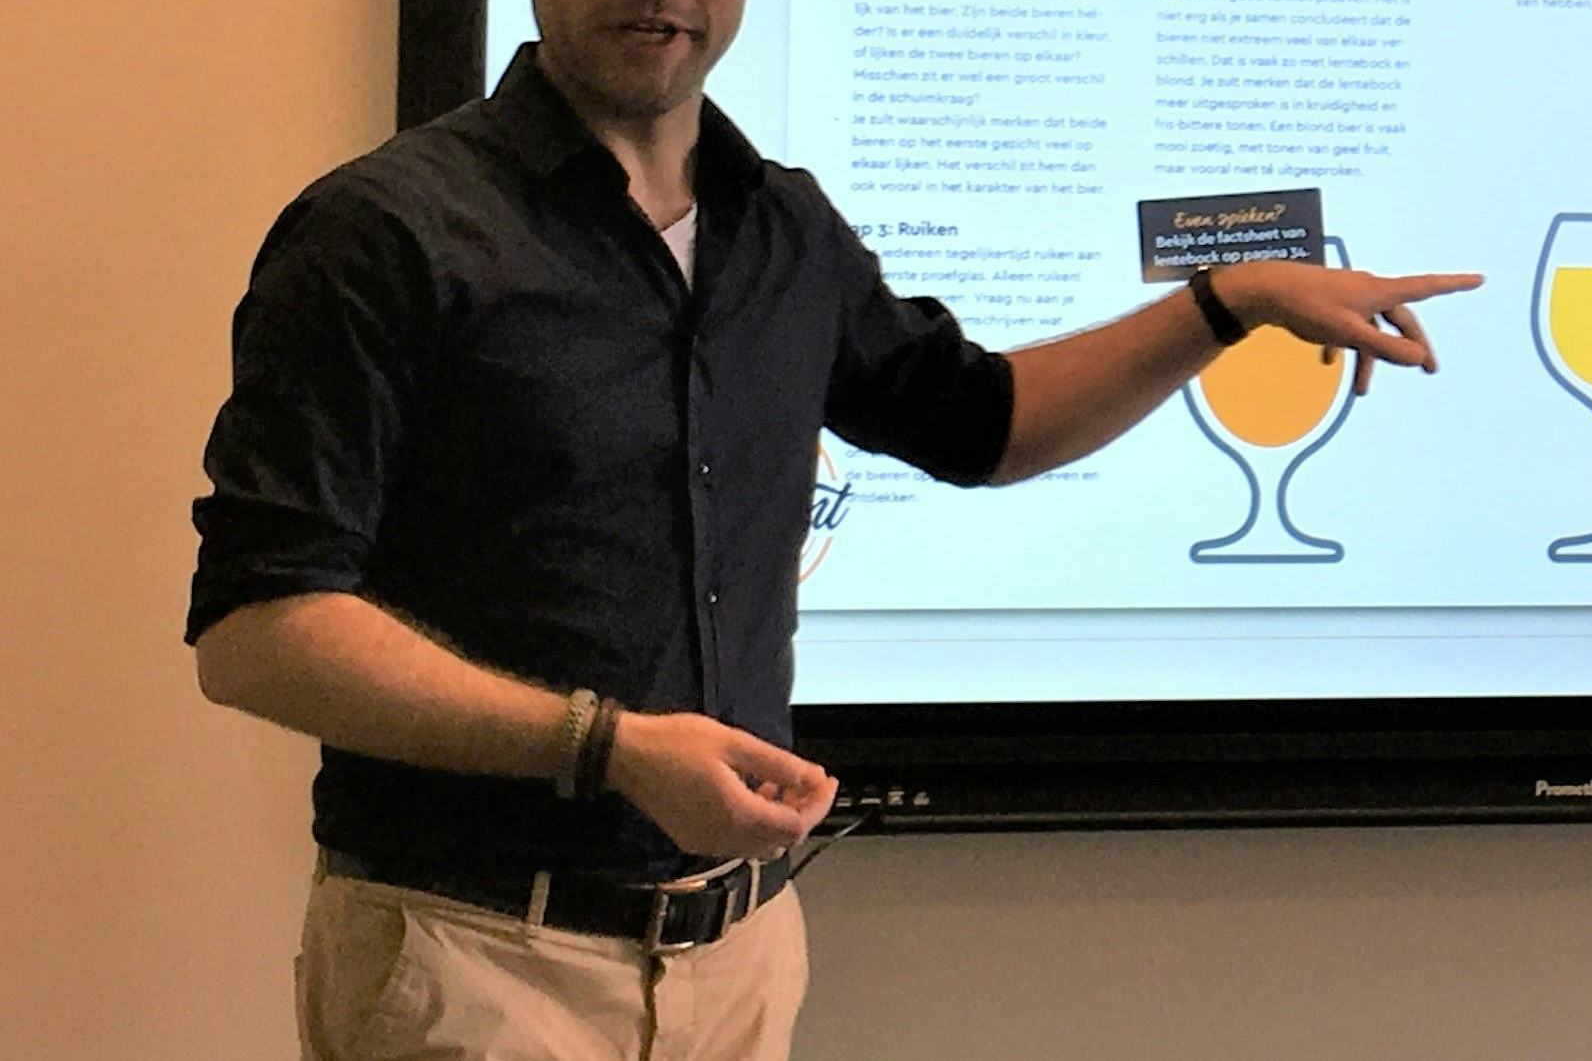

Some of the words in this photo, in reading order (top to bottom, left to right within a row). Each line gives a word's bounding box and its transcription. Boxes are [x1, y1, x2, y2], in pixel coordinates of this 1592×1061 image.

[1260, 163, 1274, 175] té
[878, 224, 893, 238] 3:
[898, 221, 959, 236] Ruiken
[1155, 232, 1195, 249] Bekijk
[1198, 231, 1216, 246] de
[1217, 228, 1280, 244] factsheet
[1281, 227, 1307, 239] van
[1154, 250, 1220, 267] lentebock
[1221, 251, 1241, 263] op
[1242, 246, 1288, 262] pagina
